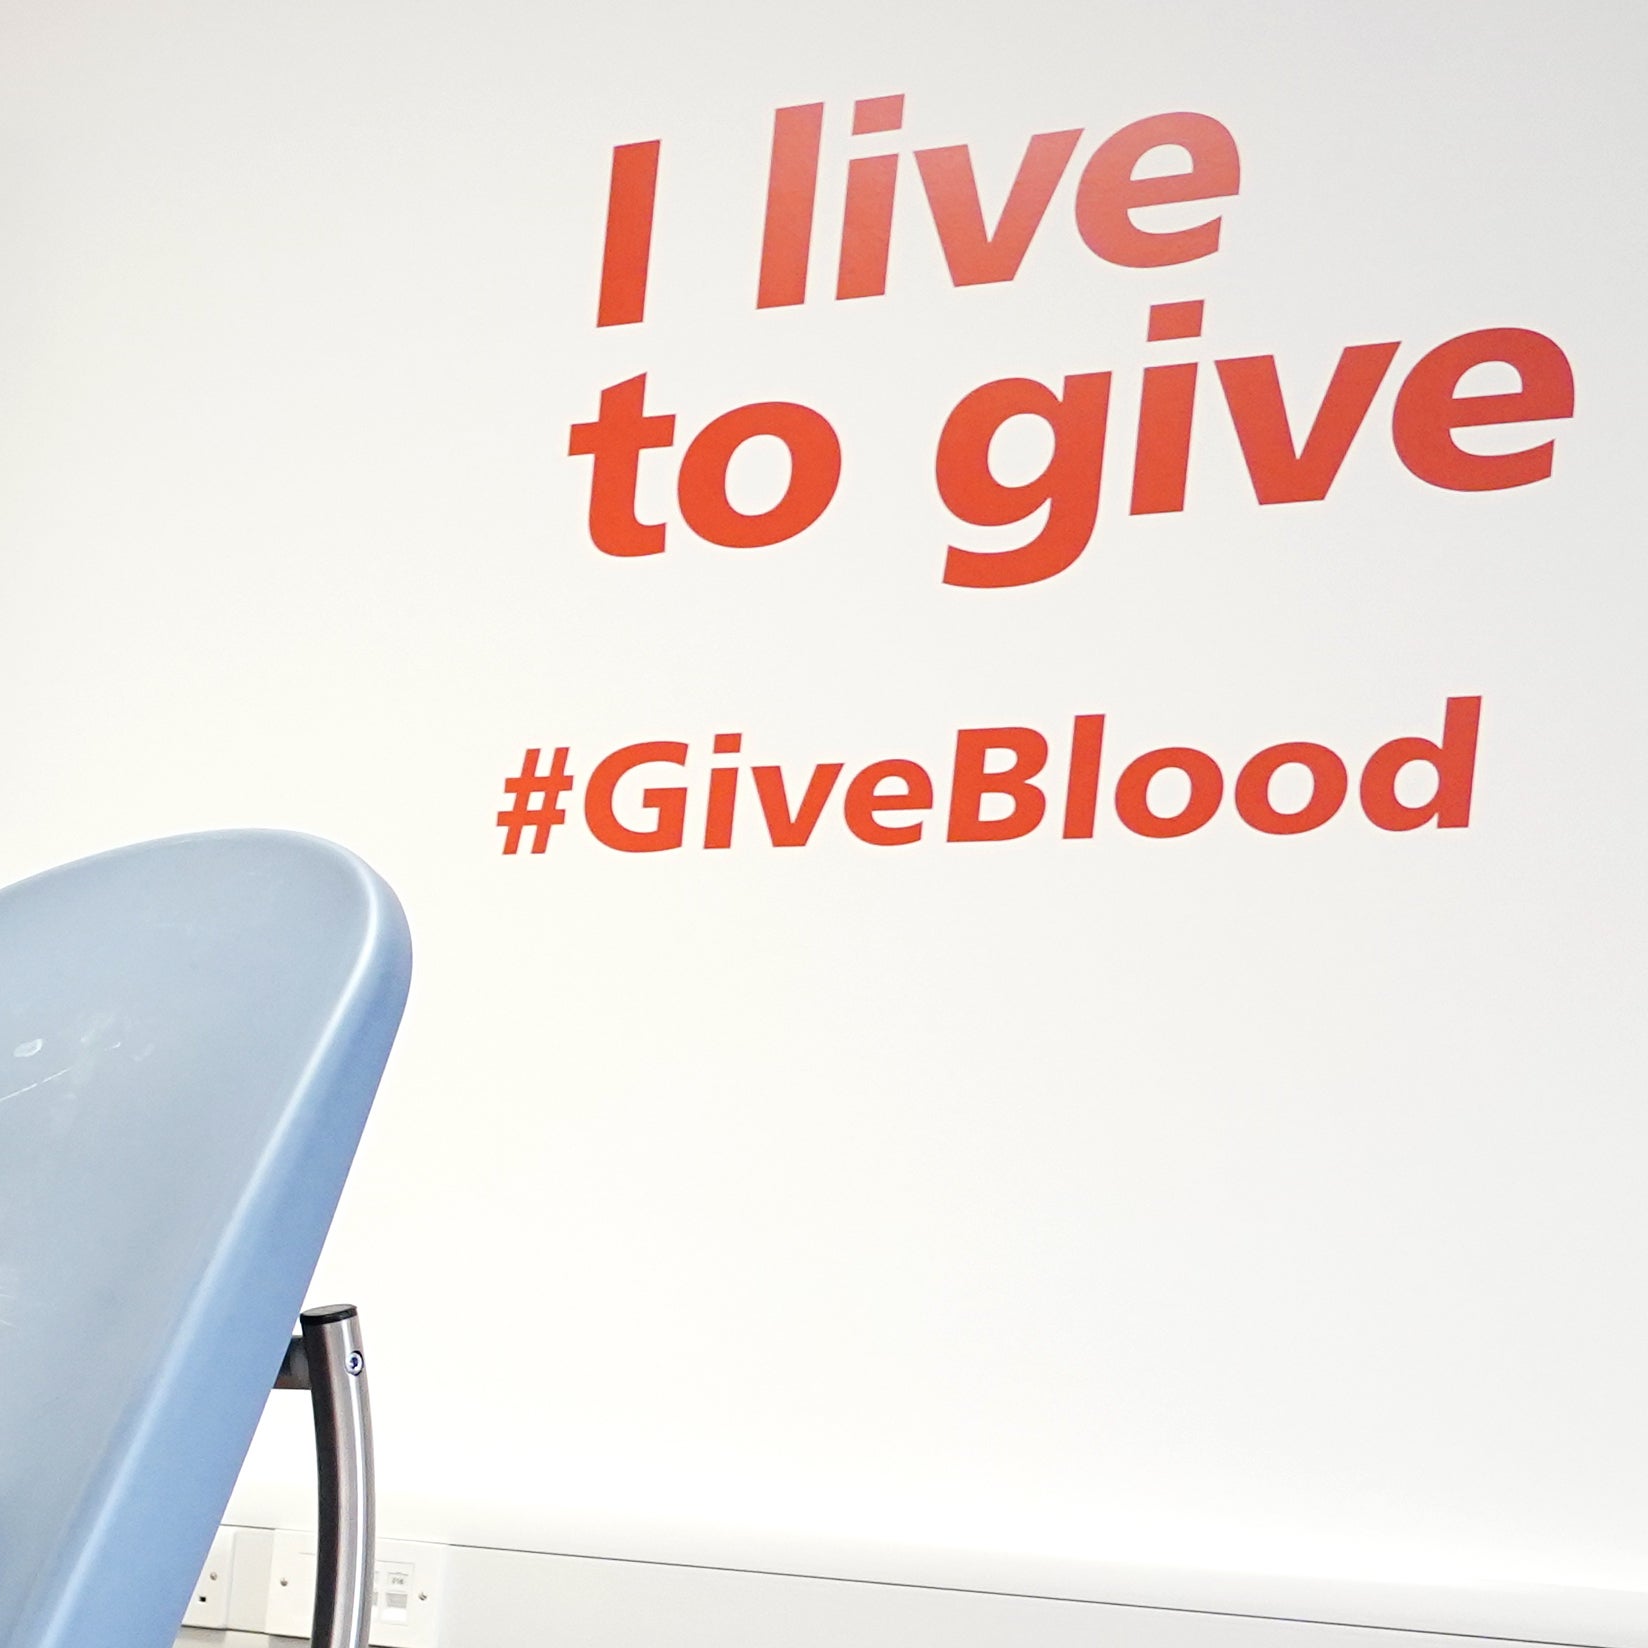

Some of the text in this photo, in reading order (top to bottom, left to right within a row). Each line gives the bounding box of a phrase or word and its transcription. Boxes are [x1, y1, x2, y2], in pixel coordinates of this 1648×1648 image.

[596, 93, 1241, 328] I live
[568, 299, 1575, 590] to give
[496, 695, 1483, 855] #GiveBlood
